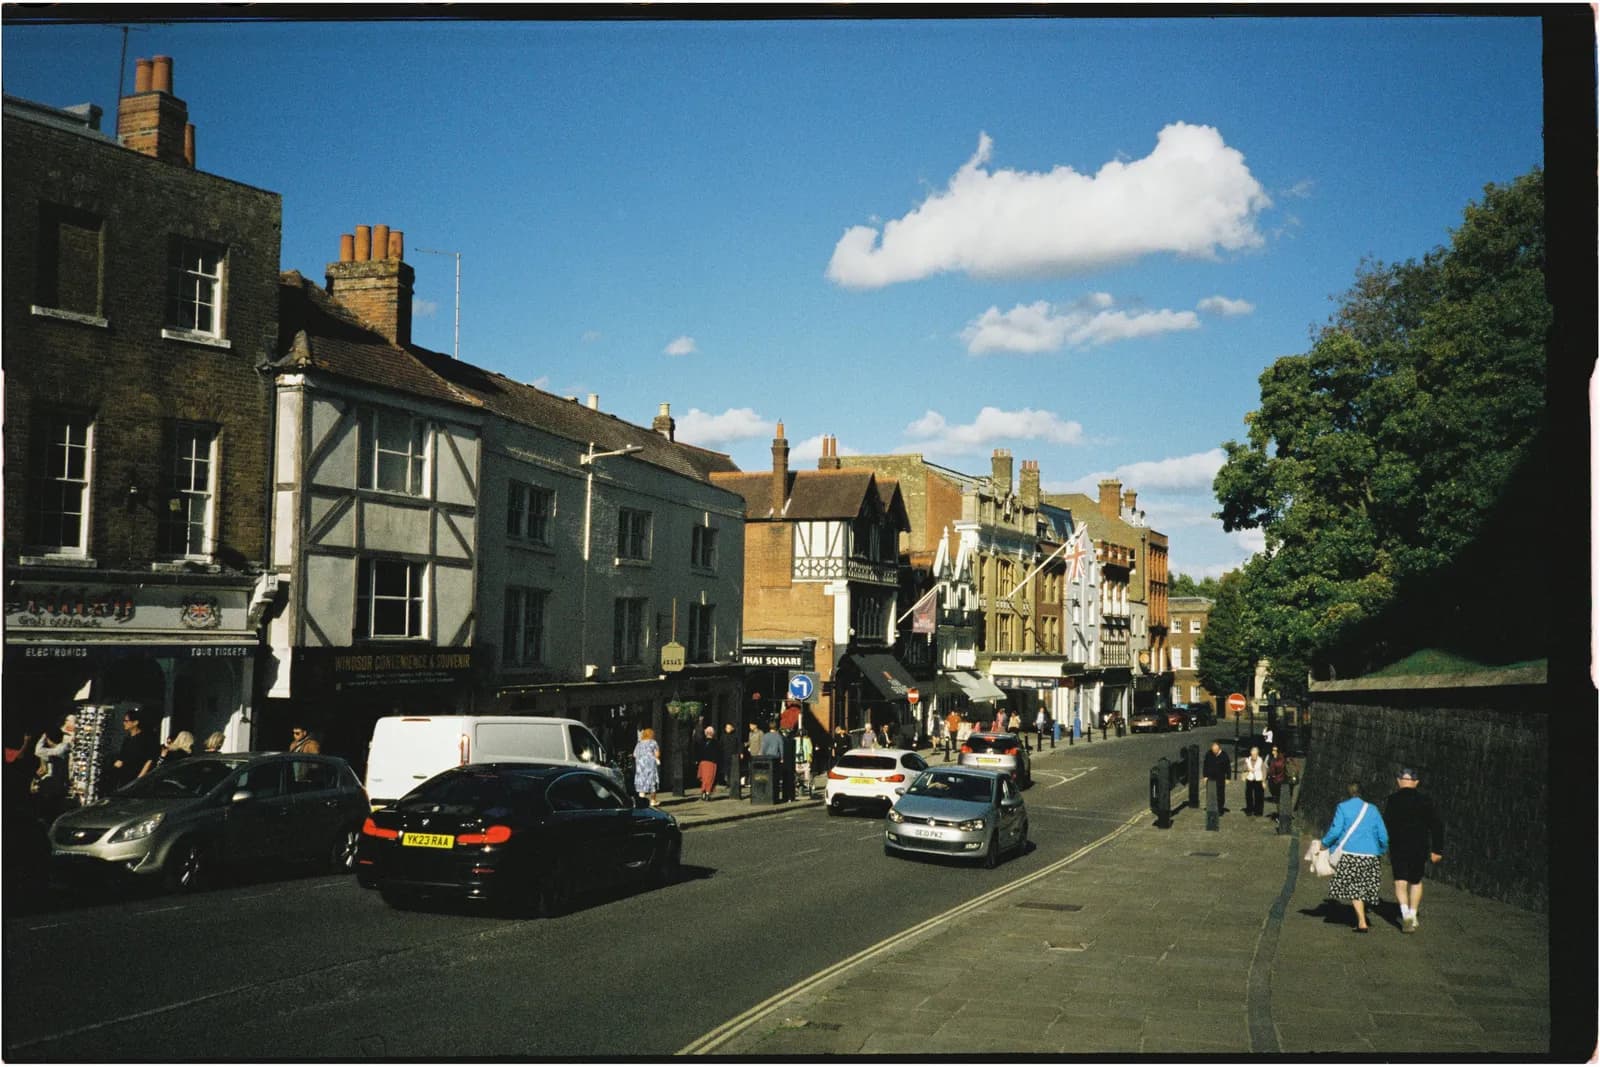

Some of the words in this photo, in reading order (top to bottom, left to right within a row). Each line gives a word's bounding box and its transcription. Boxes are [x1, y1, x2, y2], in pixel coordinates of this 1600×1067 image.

[25, 648, 88, 657] ELECTRONICS
[335, 655, 373, 671] WINDSOR
[375, 655, 429, 670] CONVENIENCE
[436, 654, 471, 669] SOUVENIR
[742, 656, 763, 665] THAI
[766, 656, 802, 666] SQUARE
[407, 834, 430, 845] YK23
[431, 836, 449, 846] RAA
